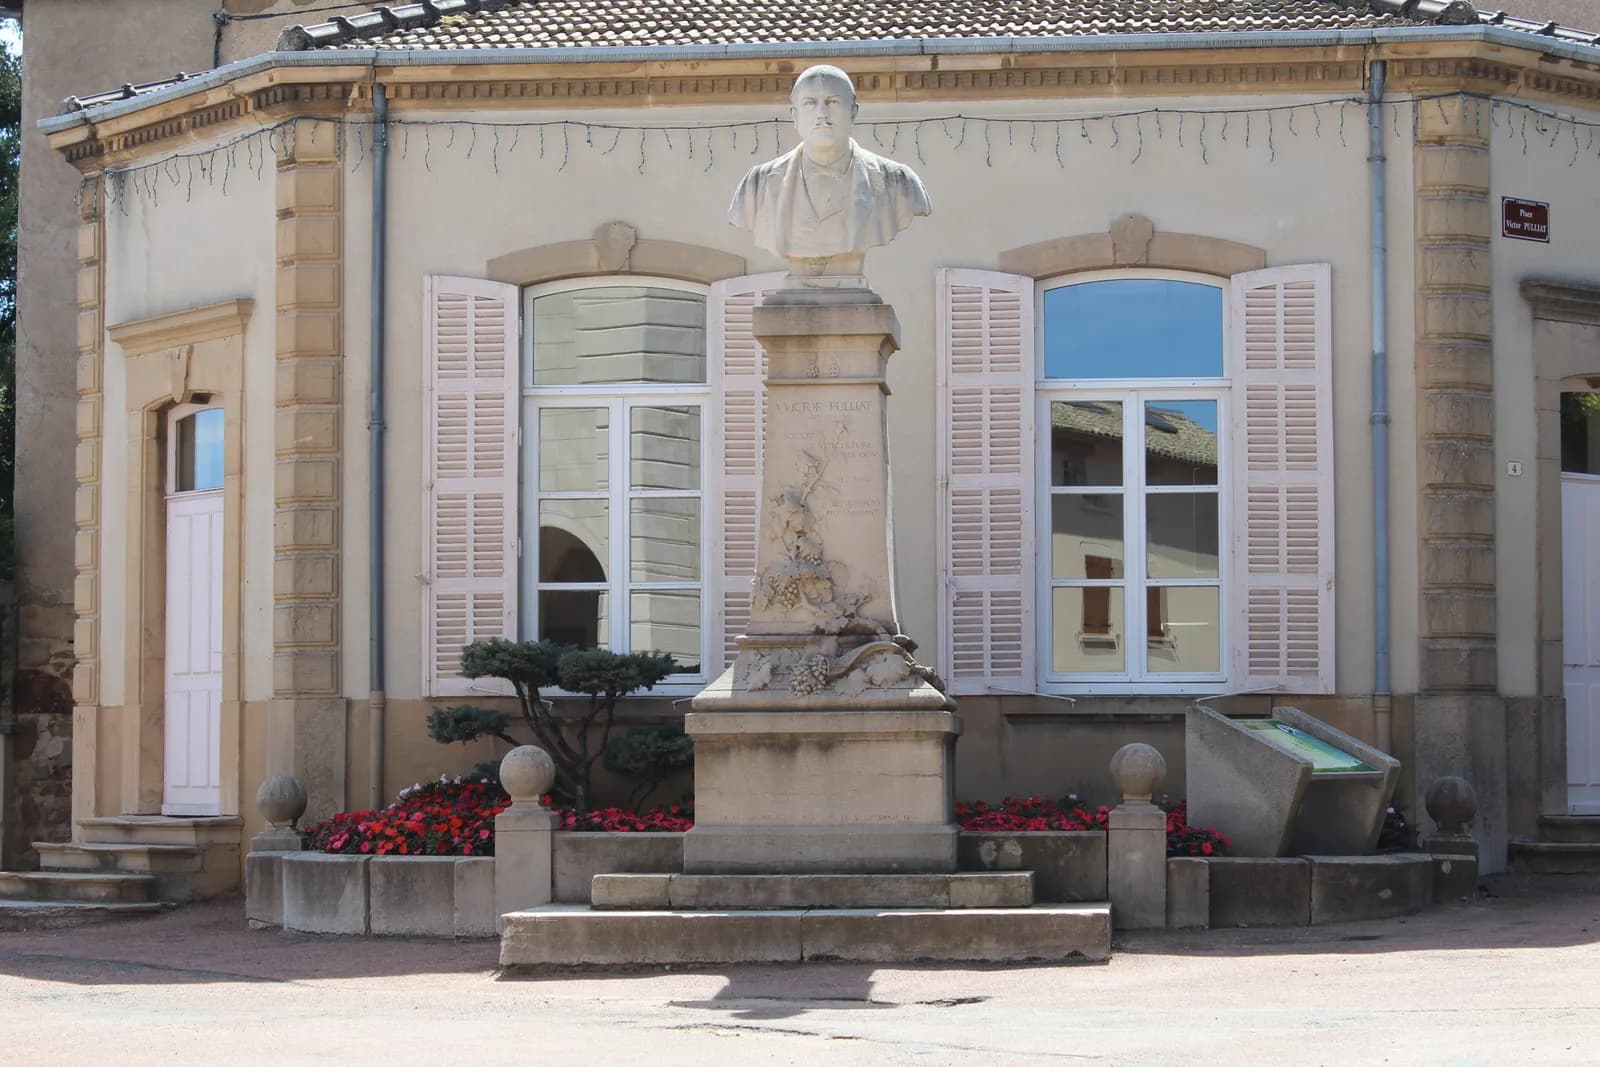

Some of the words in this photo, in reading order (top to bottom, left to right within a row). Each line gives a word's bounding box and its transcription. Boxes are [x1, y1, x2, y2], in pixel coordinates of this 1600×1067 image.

[1520, 208, 1533, 218] Place
[1506, 219, 1521, 229] Victor
[1523, 222, 1546, 233] PULLIAT
[784, 400, 821, 412] VICTOR
[829, 399, 873, 412] PULLIAT
